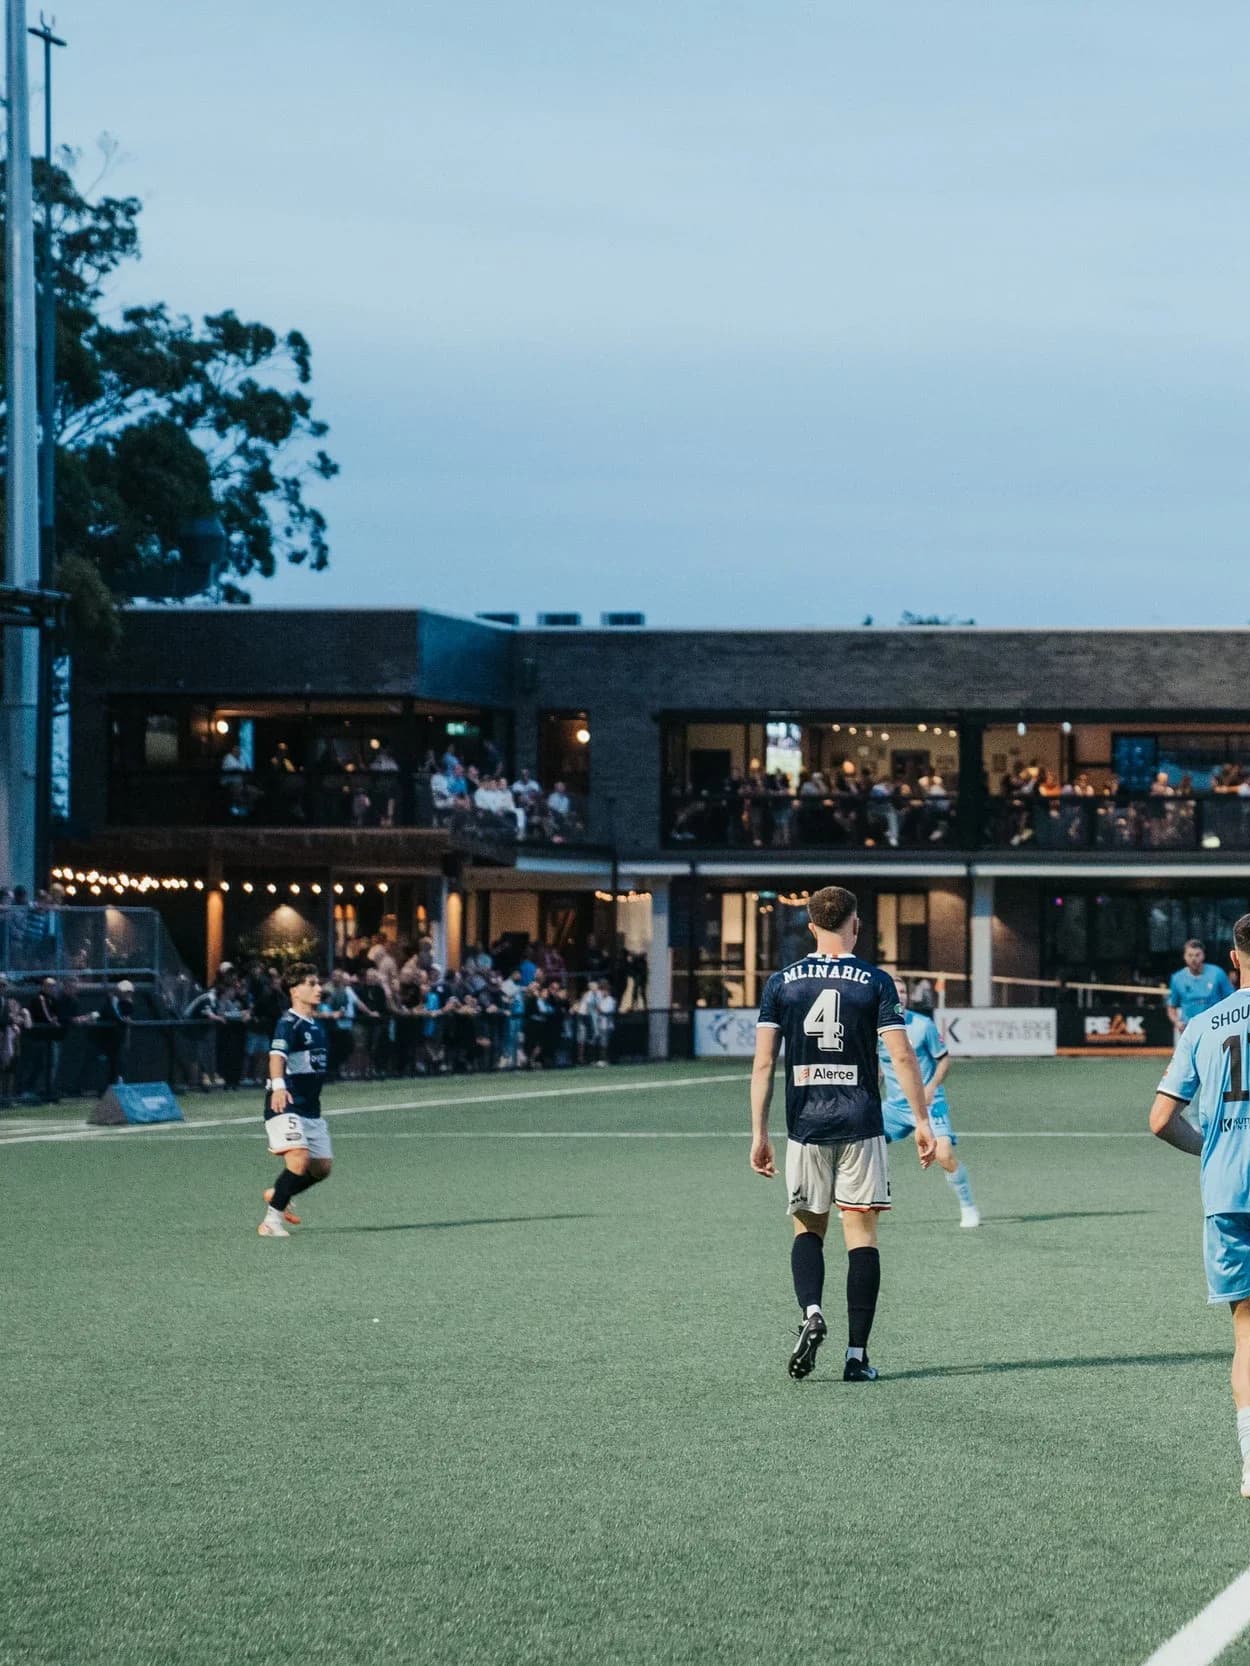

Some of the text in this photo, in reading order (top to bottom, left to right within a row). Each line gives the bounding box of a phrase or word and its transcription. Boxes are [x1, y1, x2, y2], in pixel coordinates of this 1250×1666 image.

[803, 988, 845, 1052] 4
[813, 1068, 854, 1080] Alerce
[288, 1116, 297, 1130] 5
